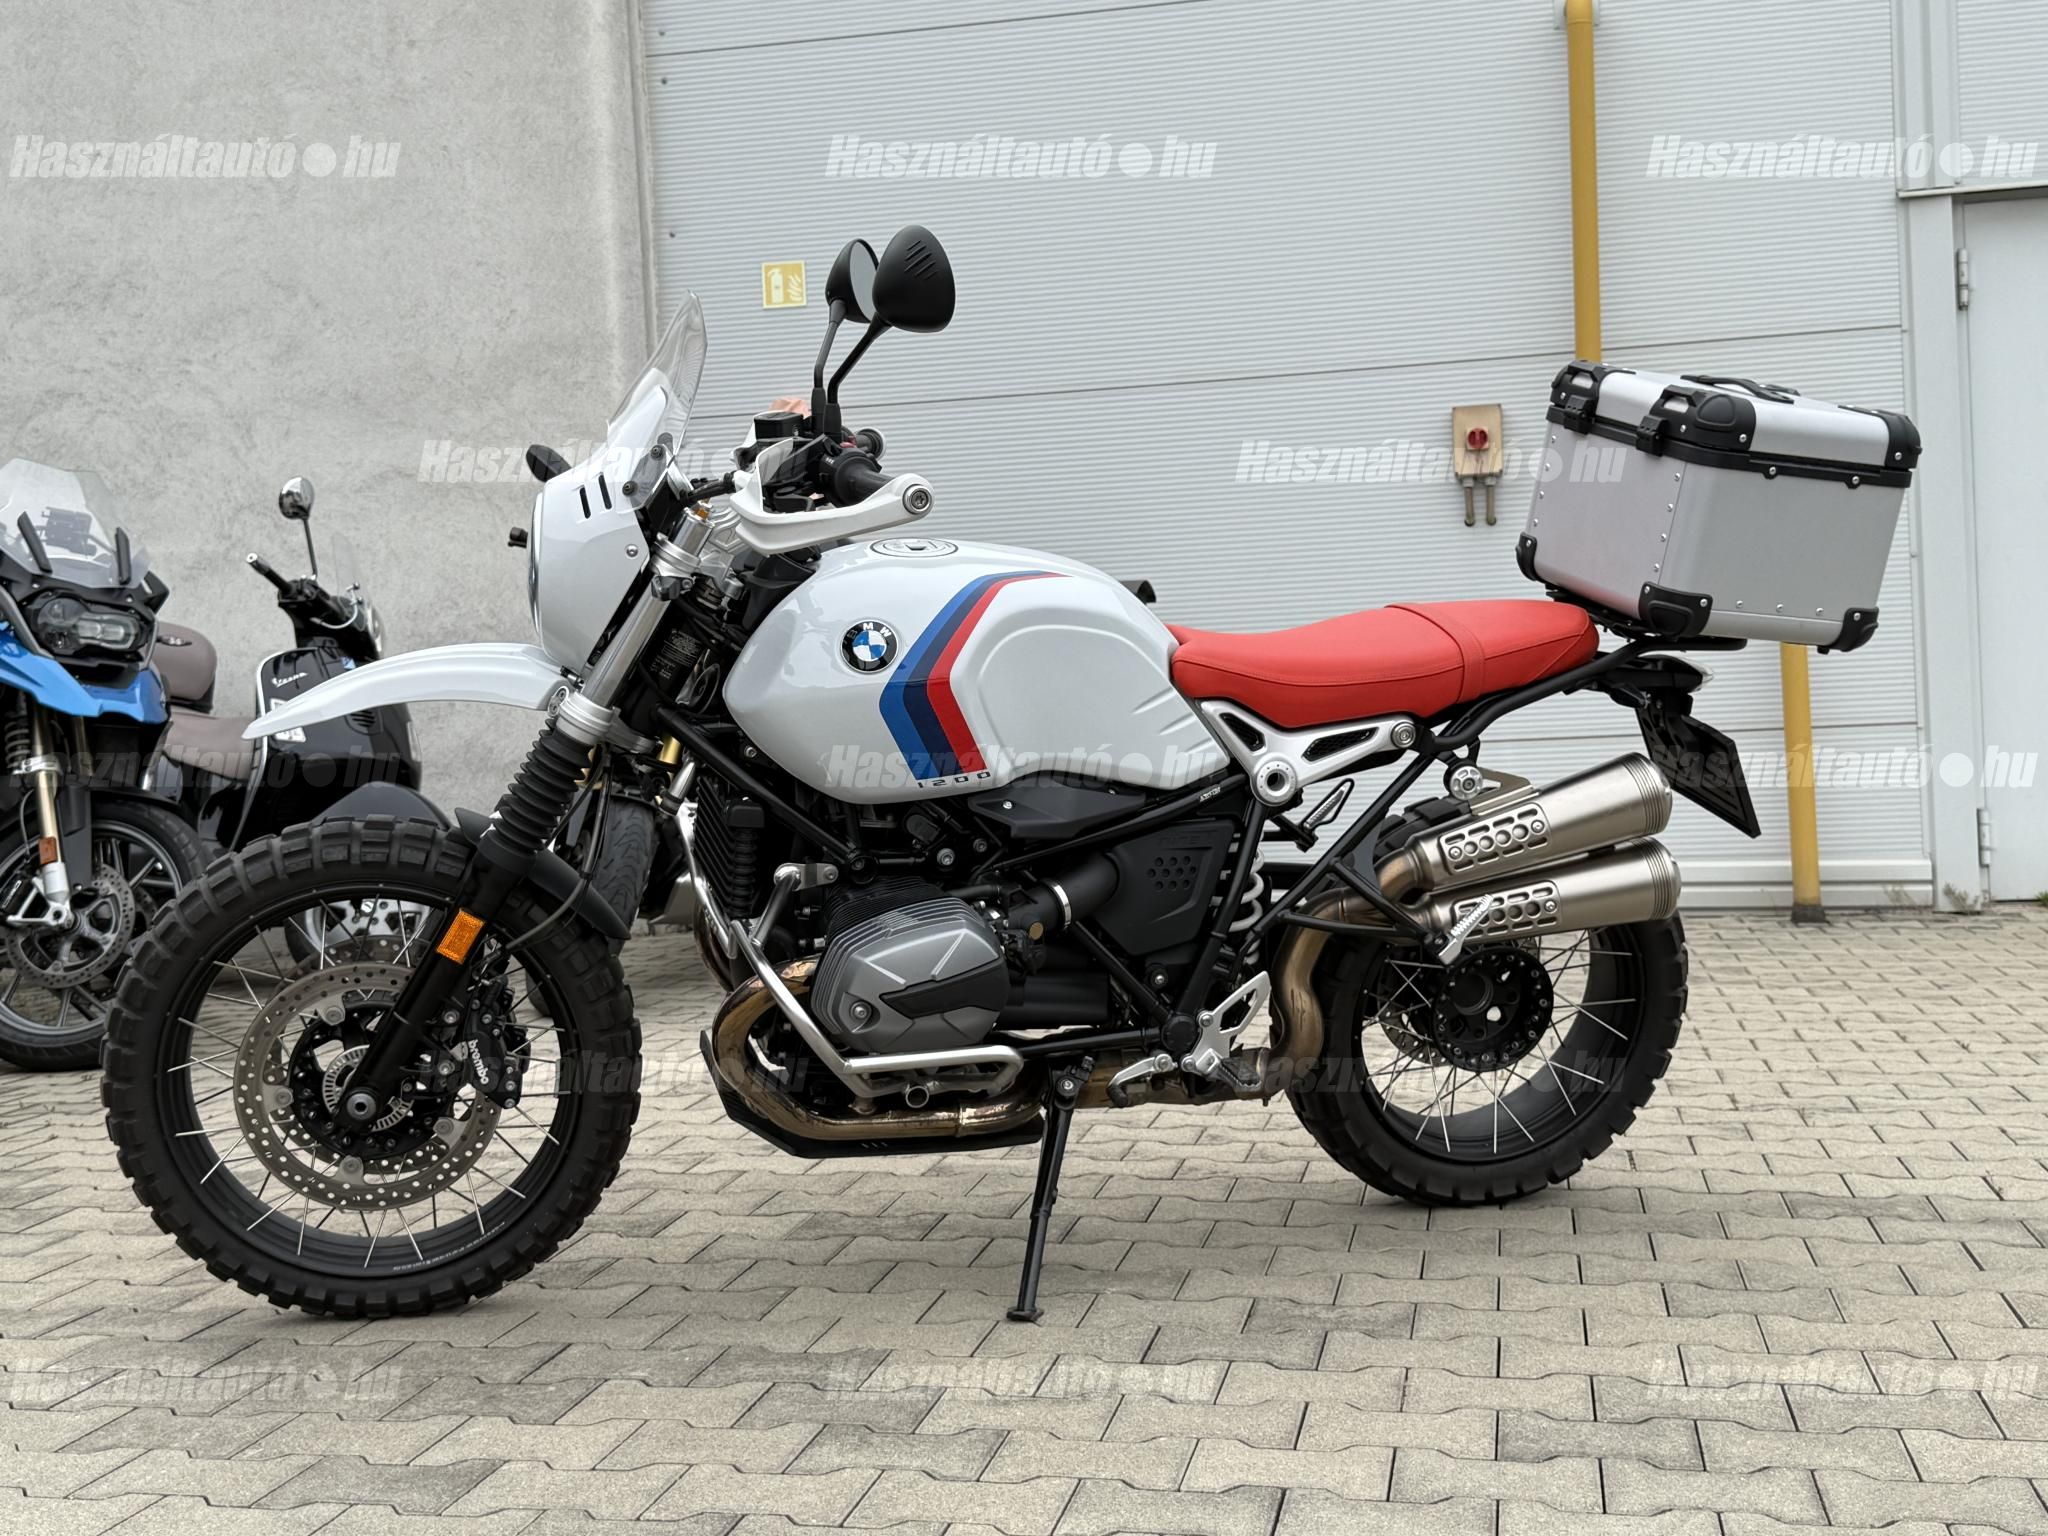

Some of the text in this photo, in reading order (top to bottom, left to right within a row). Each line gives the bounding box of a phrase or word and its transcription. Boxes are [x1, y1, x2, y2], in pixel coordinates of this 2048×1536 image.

[847, 622, 892, 639] BMW
[917, 771, 991, 788] 1200
[468, 1039, 489, 1085] brembo
